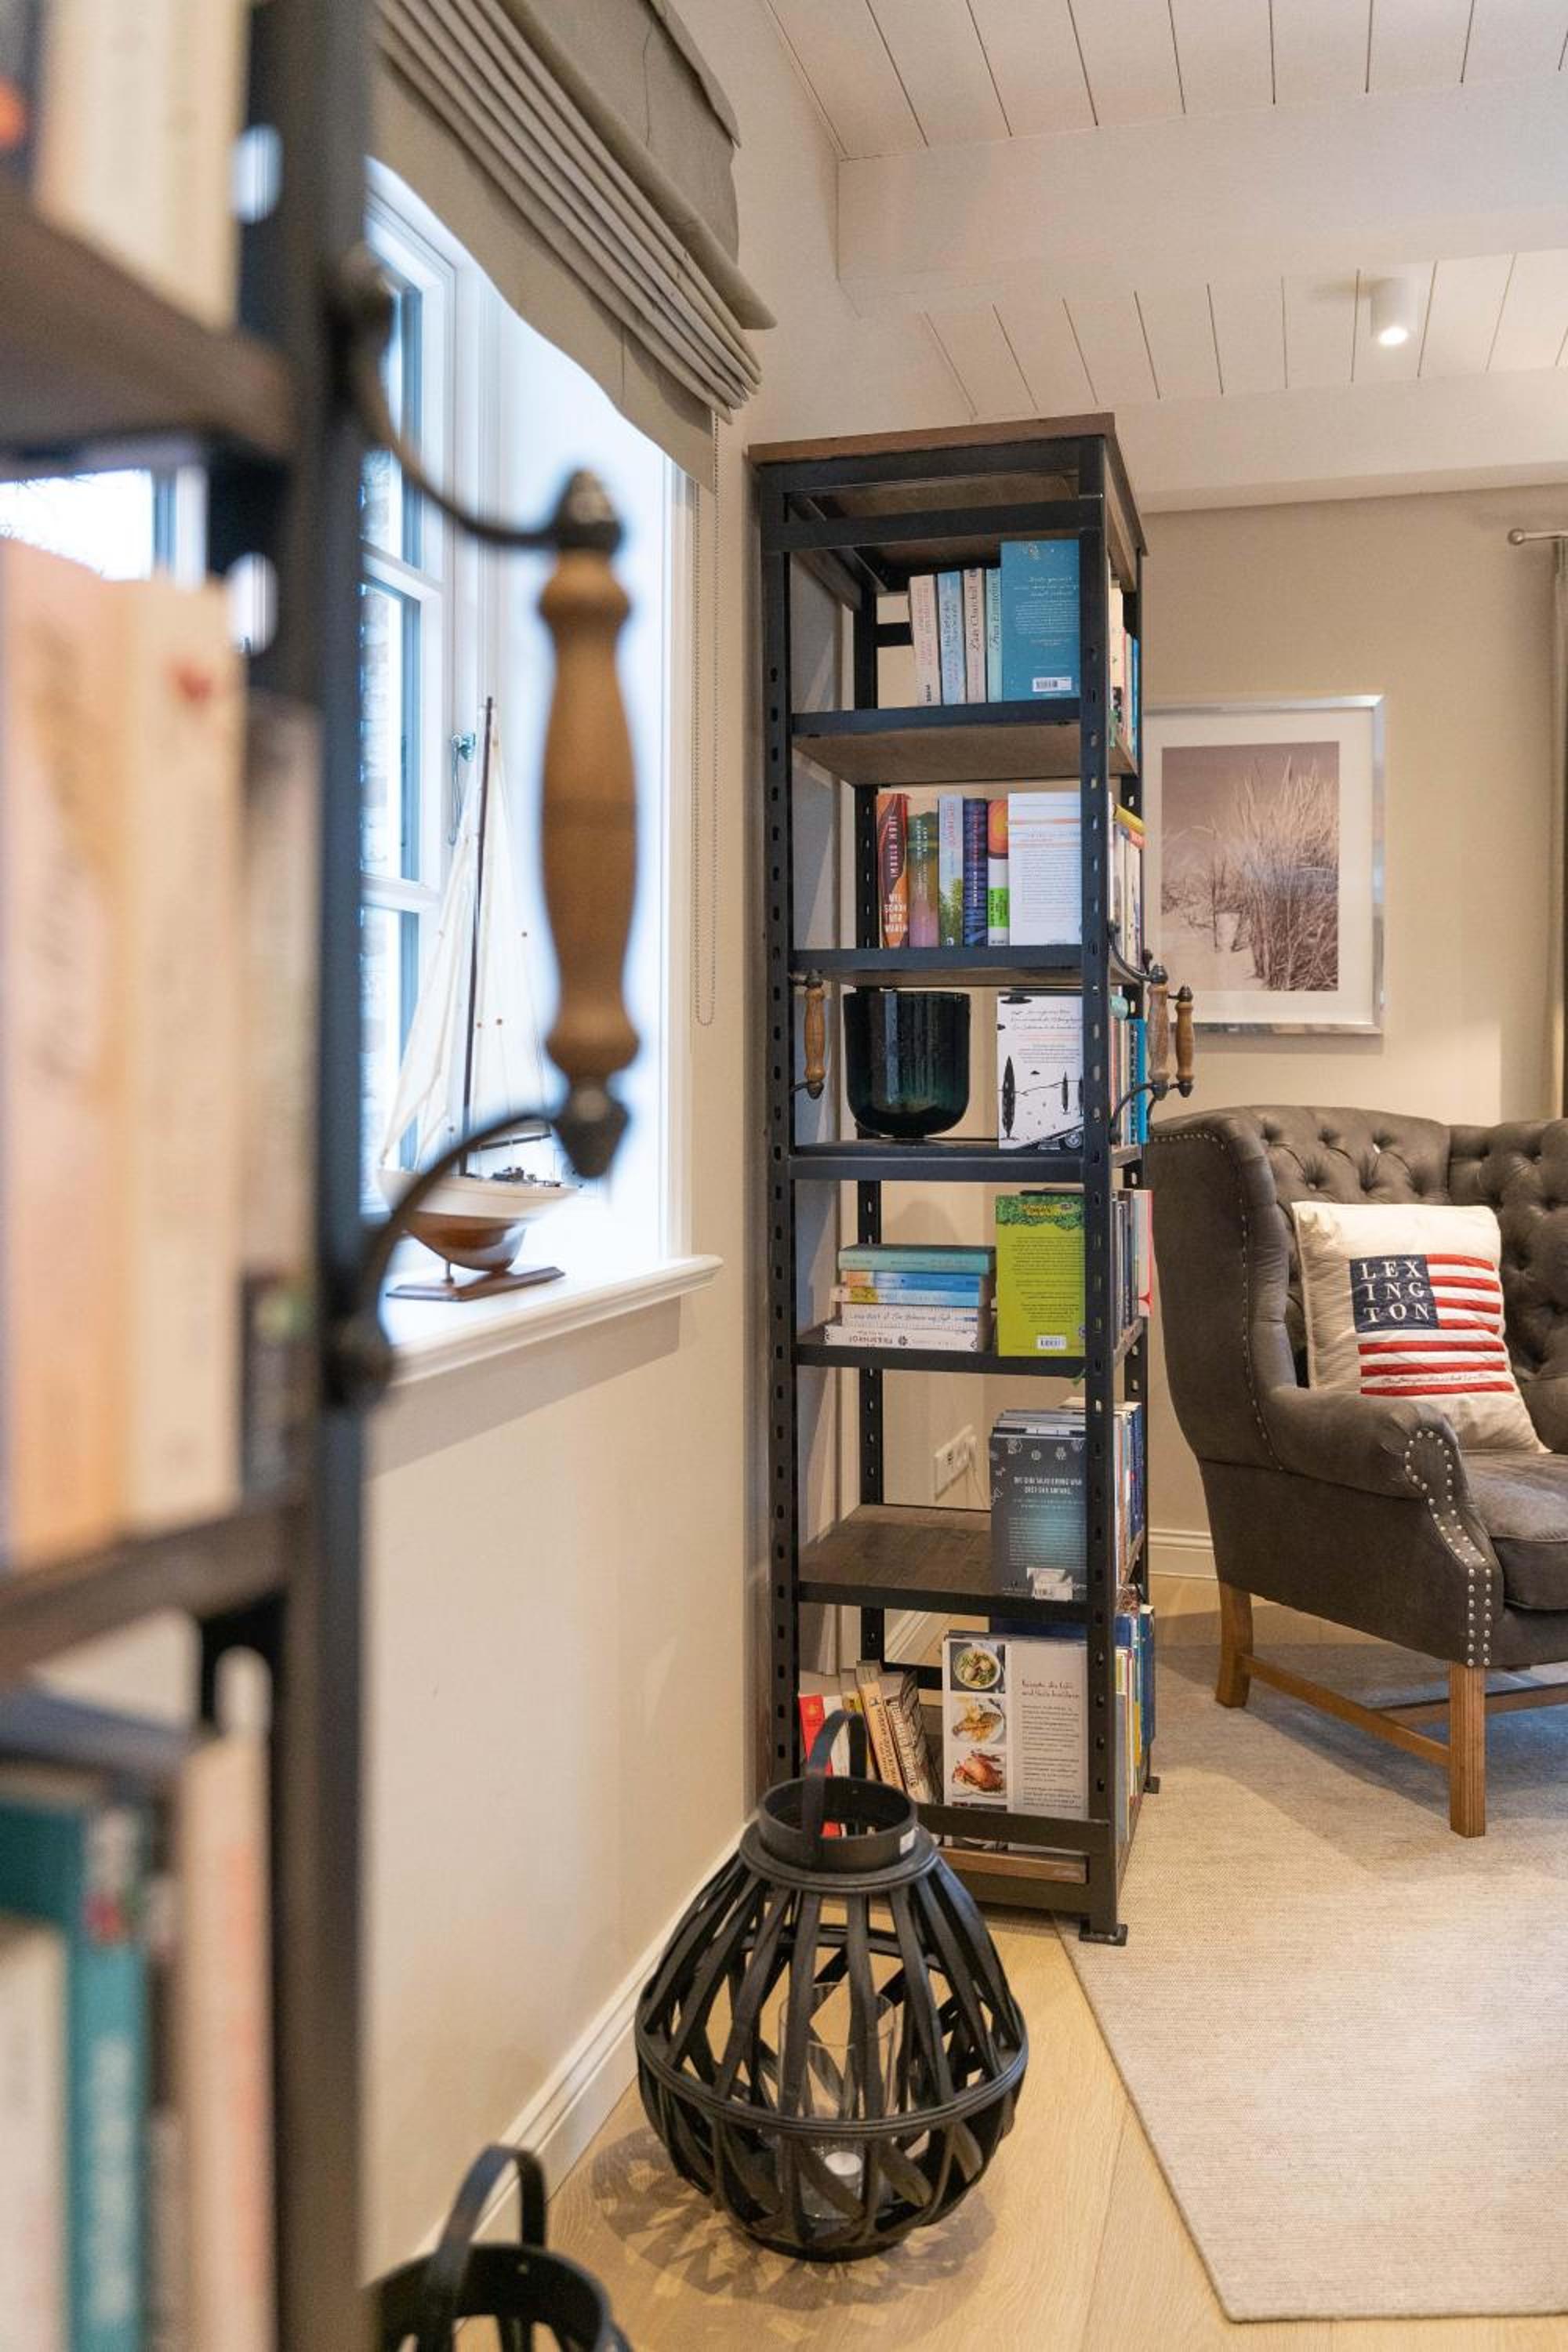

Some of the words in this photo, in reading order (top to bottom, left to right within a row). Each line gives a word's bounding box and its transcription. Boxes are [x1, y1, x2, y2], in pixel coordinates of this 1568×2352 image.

[1359, 1260, 1423, 1280] LEX
[1364, 1282, 1425, 1301] ING
[1363, 1303, 1429, 1323] TON
